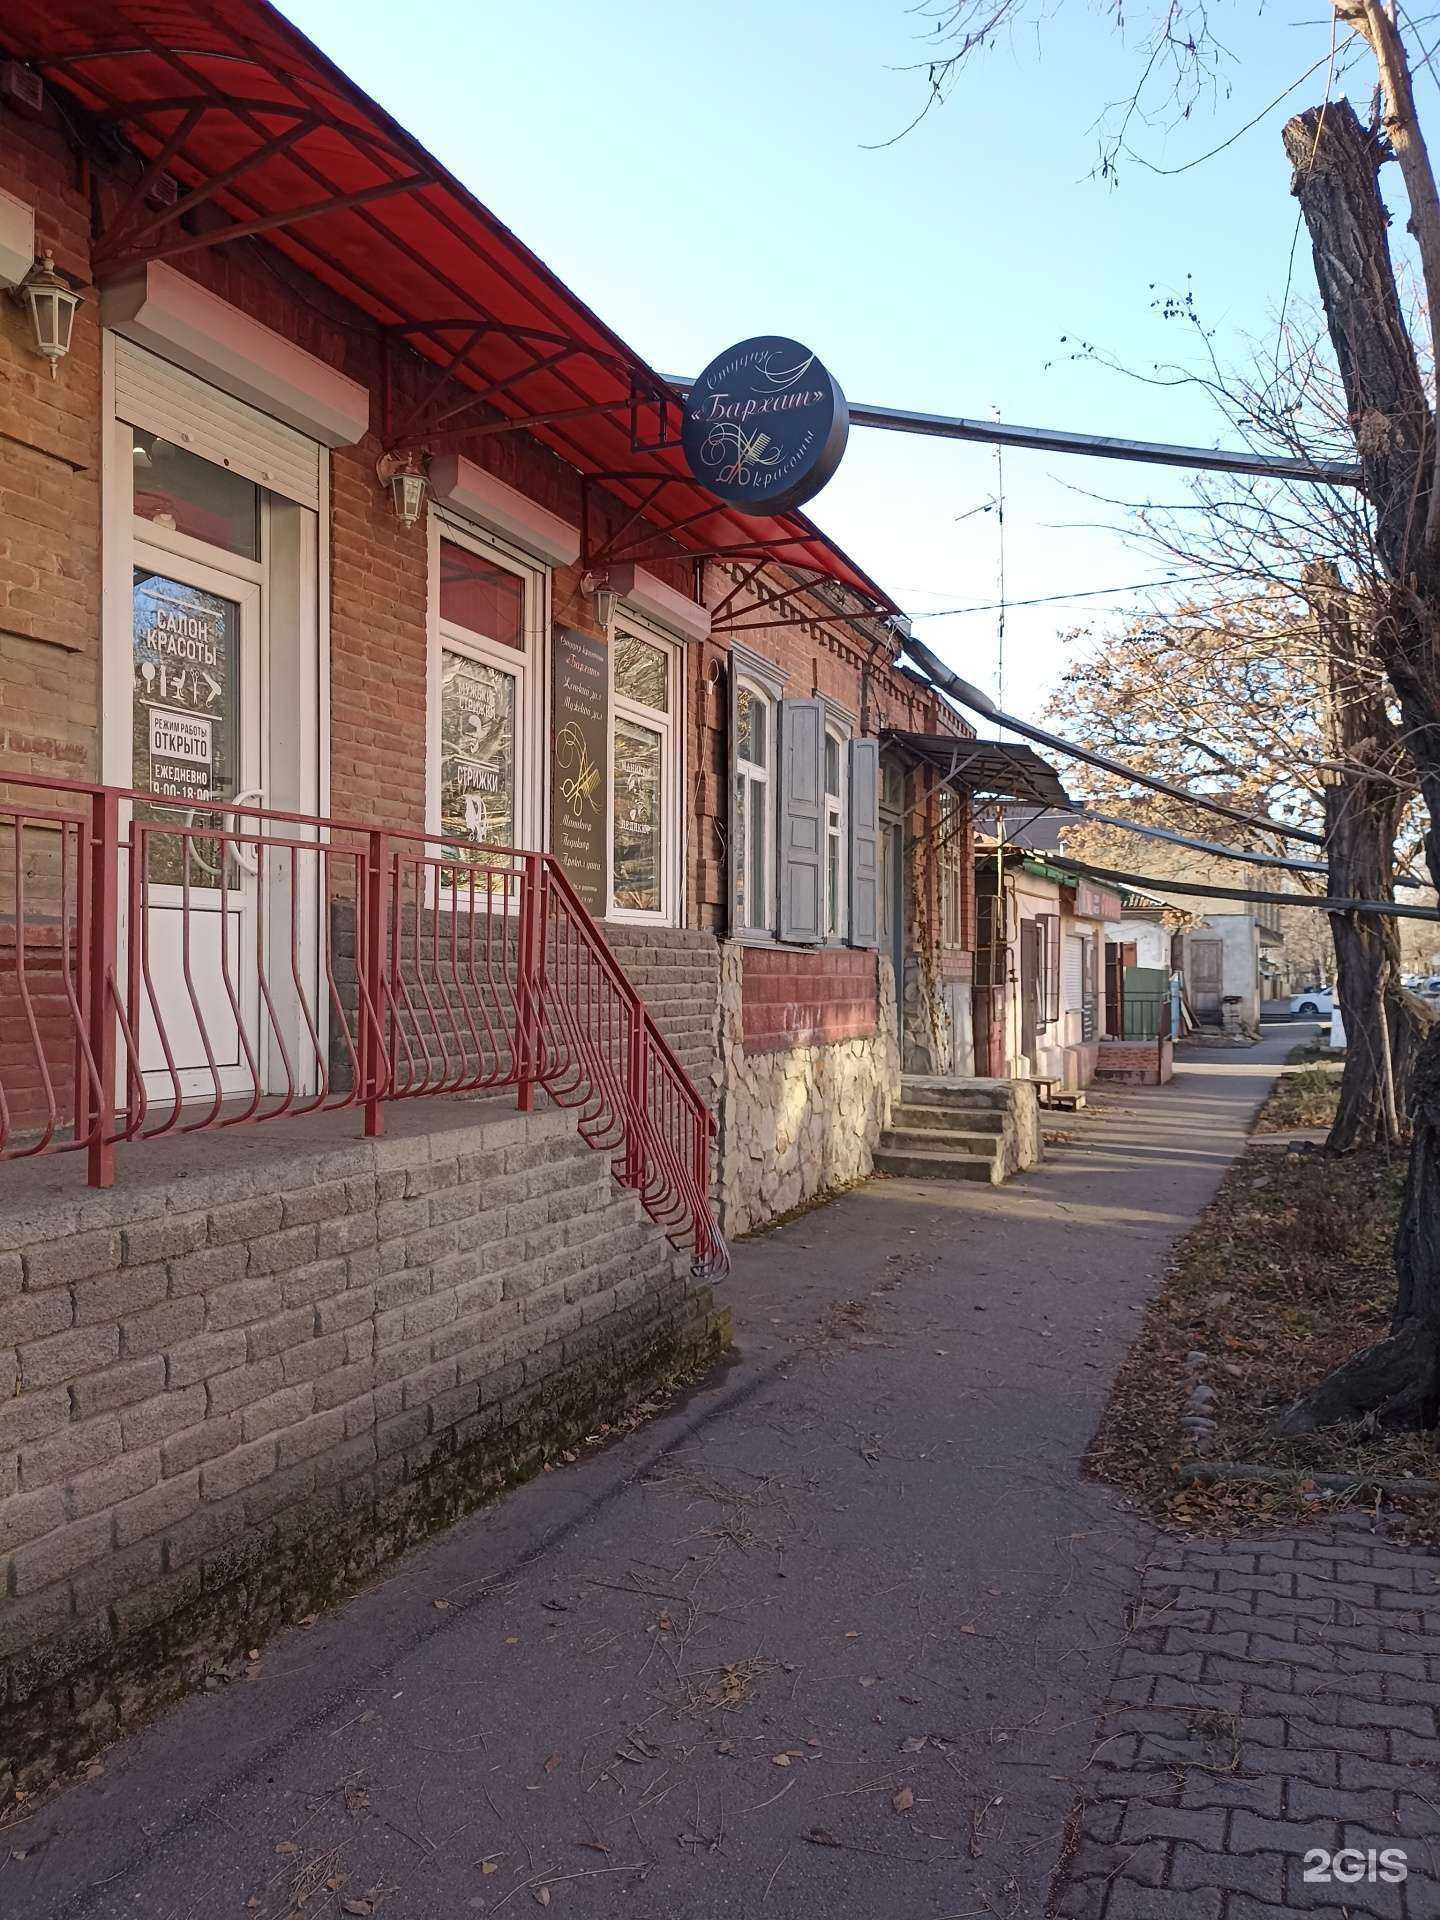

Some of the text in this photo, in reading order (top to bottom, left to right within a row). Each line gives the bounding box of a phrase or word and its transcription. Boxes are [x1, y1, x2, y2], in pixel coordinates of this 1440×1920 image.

[690, 391, 825, 422] «Бархат»
[752, 429, 816, 489] красоты
[157, 608, 209, 643] САЛОН
[147, 628, 217, 666] КРАСОТЫ
[154, 717, 207, 738] РЕЖИМ РАБОТЫ
[154, 731, 207, 757] ОТКРЫТО
[155, 763, 208, 785] ЕЖЕДНЕВНО
[457, 765, 498, 794] СТРИЖКИ
